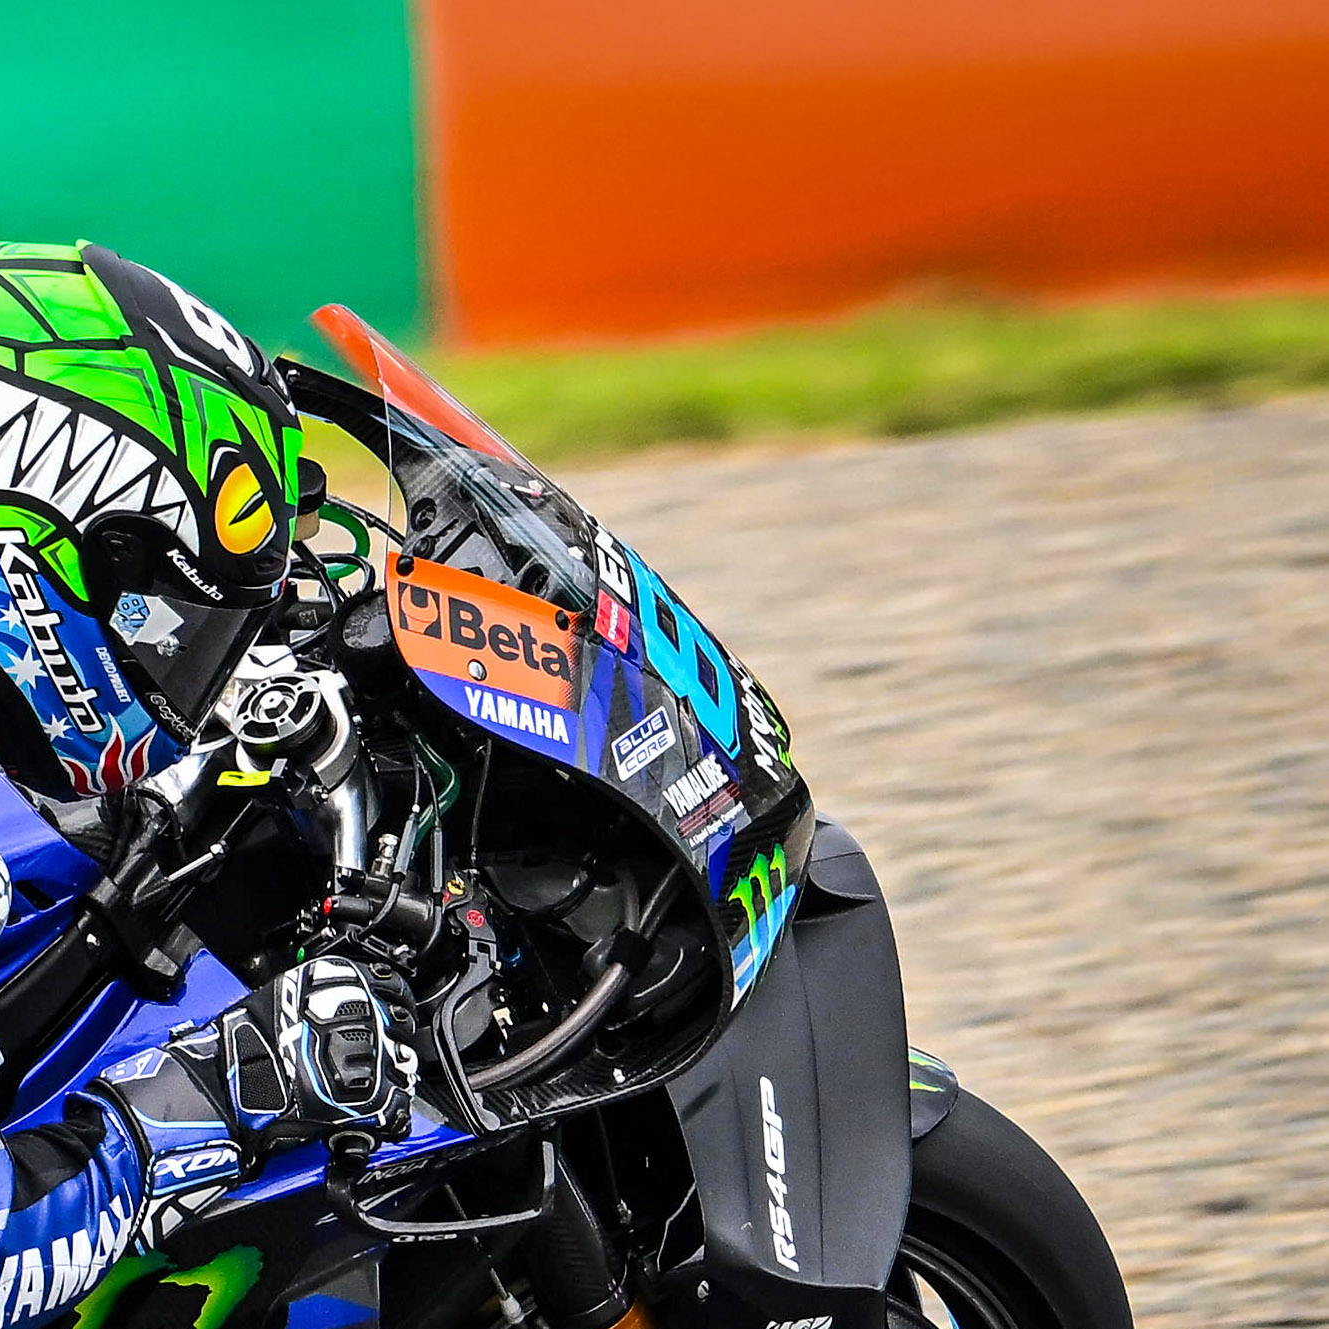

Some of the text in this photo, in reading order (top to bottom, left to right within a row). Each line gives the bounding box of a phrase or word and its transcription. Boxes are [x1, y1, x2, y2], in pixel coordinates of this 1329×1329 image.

[166, 548, 224, 601] Kabuto
[448, 596, 572, 682] Beta
[607, 600, 619, 641] ENEOS
[464, 686, 570, 744] YAMAHA
[618, 713, 665, 757] BLUE
[625, 733, 670, 773] CORE
[662, 751, 730, 818] YAMALUBE
[759, 1075, 800, 1273] RS4GP
